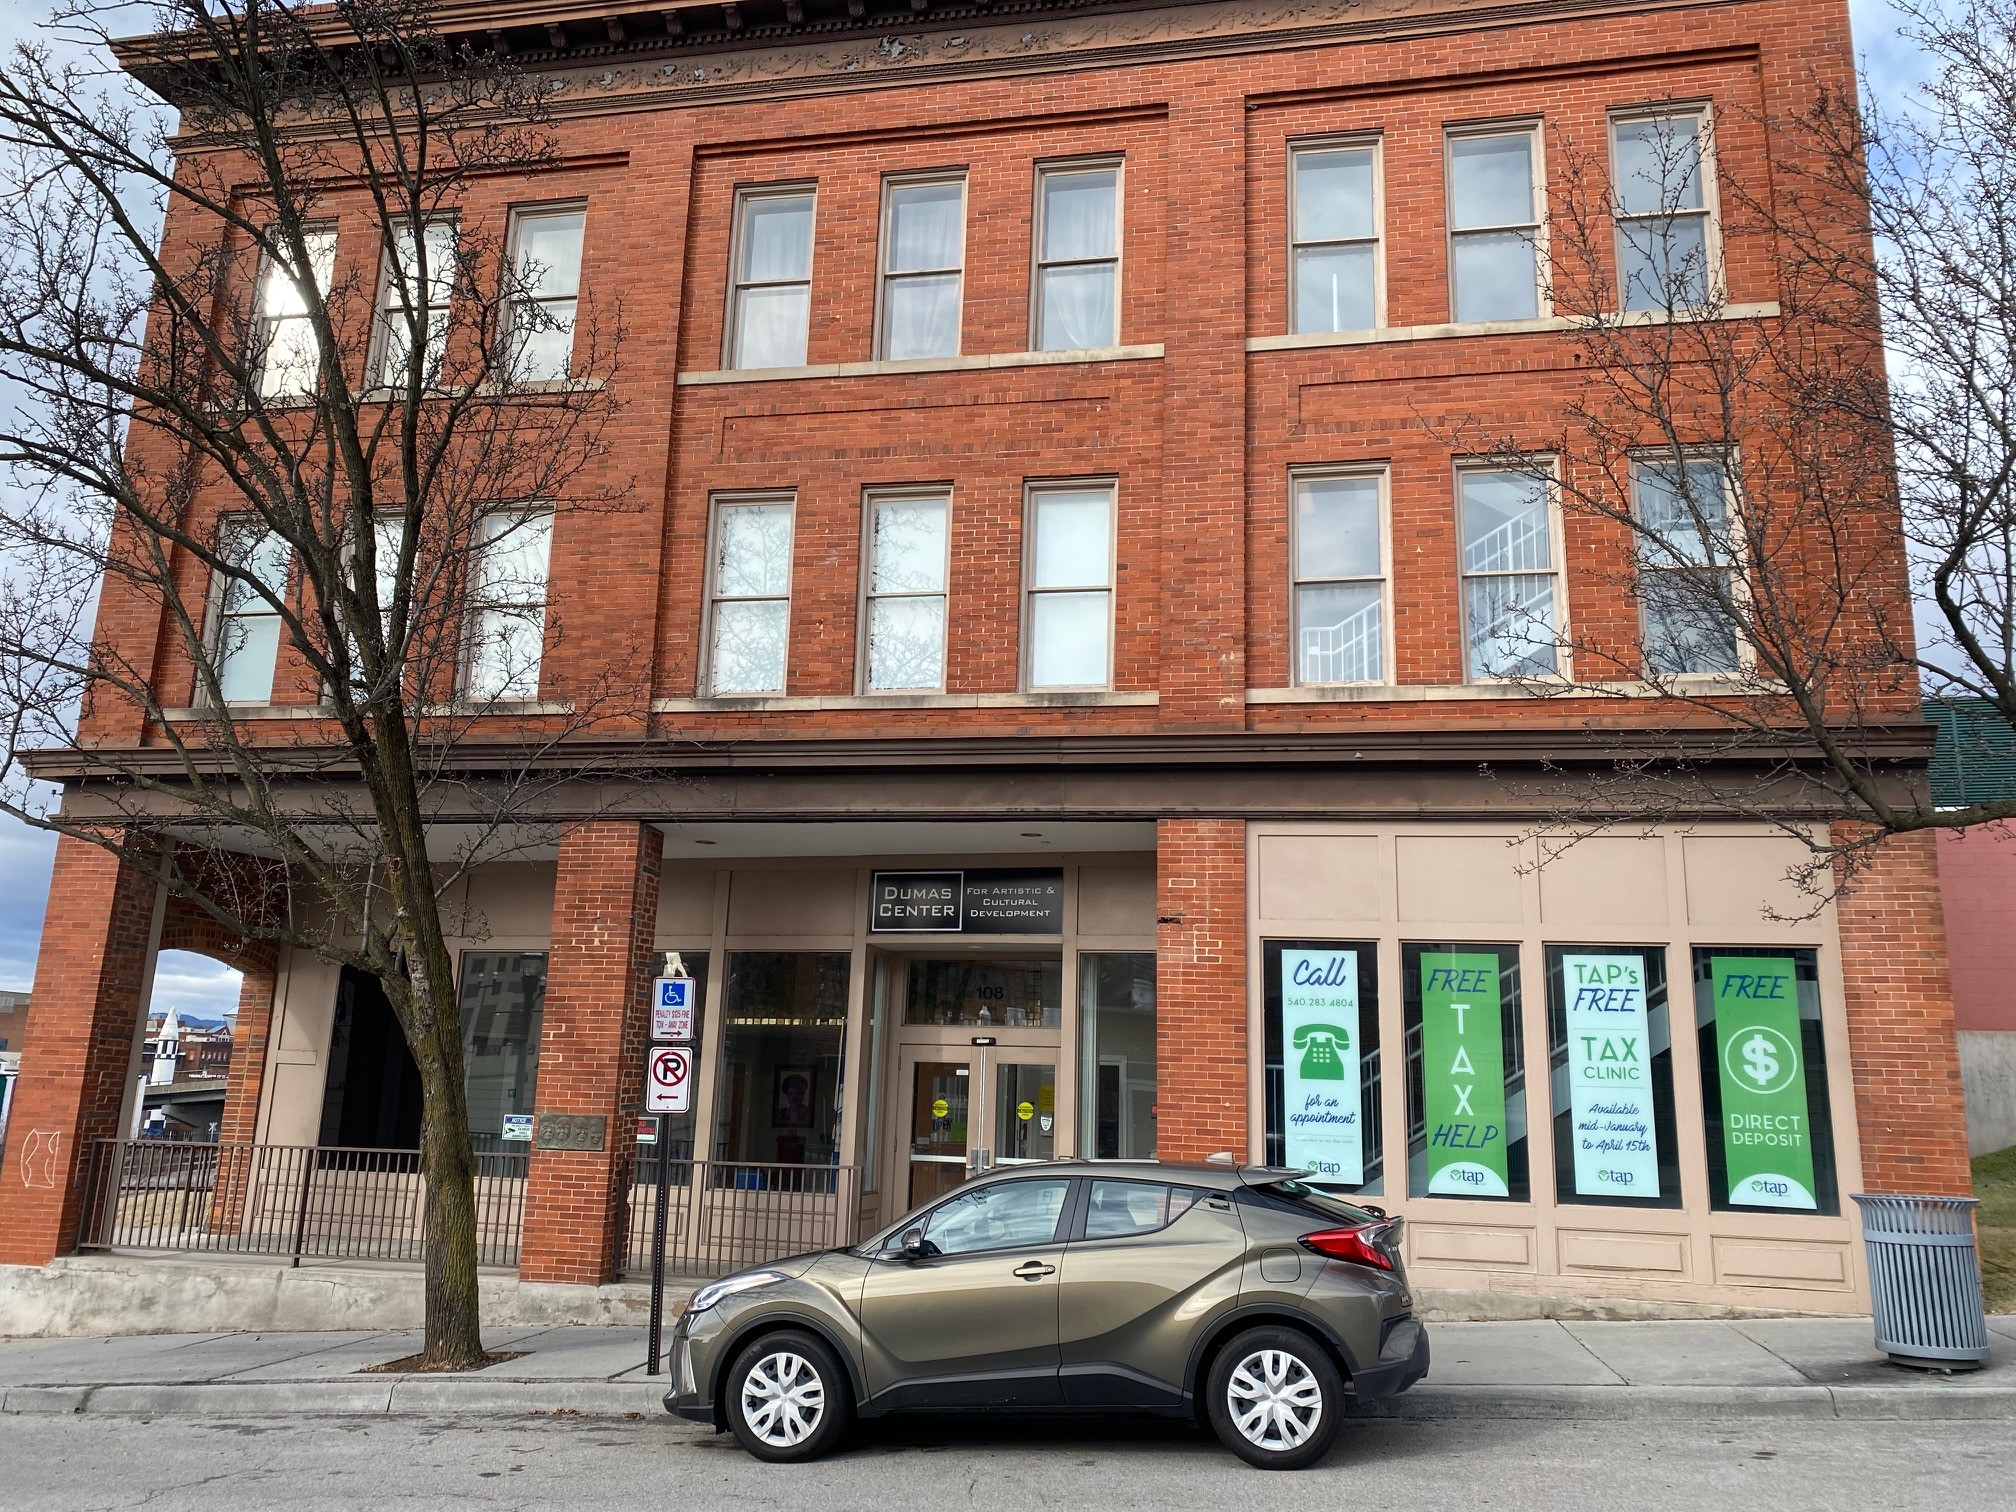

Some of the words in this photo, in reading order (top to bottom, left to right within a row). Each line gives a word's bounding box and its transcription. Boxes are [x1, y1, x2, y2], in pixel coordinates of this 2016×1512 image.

[884, 887, 952, 900] DUMAS
[966, 887, 988, 895] FOR
[992, 887, 1042, 895] ARTISTIC
[1046, 886, 1056, 895] &
[982, 898, 1039, 906] CULTURAL
[879, 903, 955, 917] CENTER
[970, 909, 1051, 918] DEVELOPMENT
[1293, 957, 1347, 987] Call
[1427, 968, 1492, 993] FREE
[1721, 975, 1789, 999] FREE
[976, 986, 1004, 1000] 108
[1573, 988, 1640, 1012] FREE
[1287, 997, 1306, 1007] 540
[1308, 998, 1326, 1007] 283
[1329, 999, 1354, 1008] 4804
[1581, 1036, 1639, 1063] TAX
[1450, 1004, 1475, 1116] TAX
[1584, 1066, 1640, 1080] CLINIC
[1304, 1094, 1322, 1109] for
[1324, 1098, 1339, 1107] an
[1589, 1103, 1640, 1116] Available
[1290, 1111, 1357, 1127] appointment
[1731, 1114, 1800, 1130] DIRECT
[1432, 1123, 1499, 1149] HELP
[1578, 1121, 1648, 1136] mid-January
[1582, 1138, 1594, 1150] to
[1596, 1140, 1623, 1154] April
[1625, 1141, 1651, 1152] 15th
[1732, 1132, 1802, 1147] DEPOSIT
[1318, 1161, 1341, 1176] tap
[1461, 1169, 1485, 1185] tap
[1610, 1169, 1634, 1185] tap
[1763, 1180, 1788, 1196] tap
